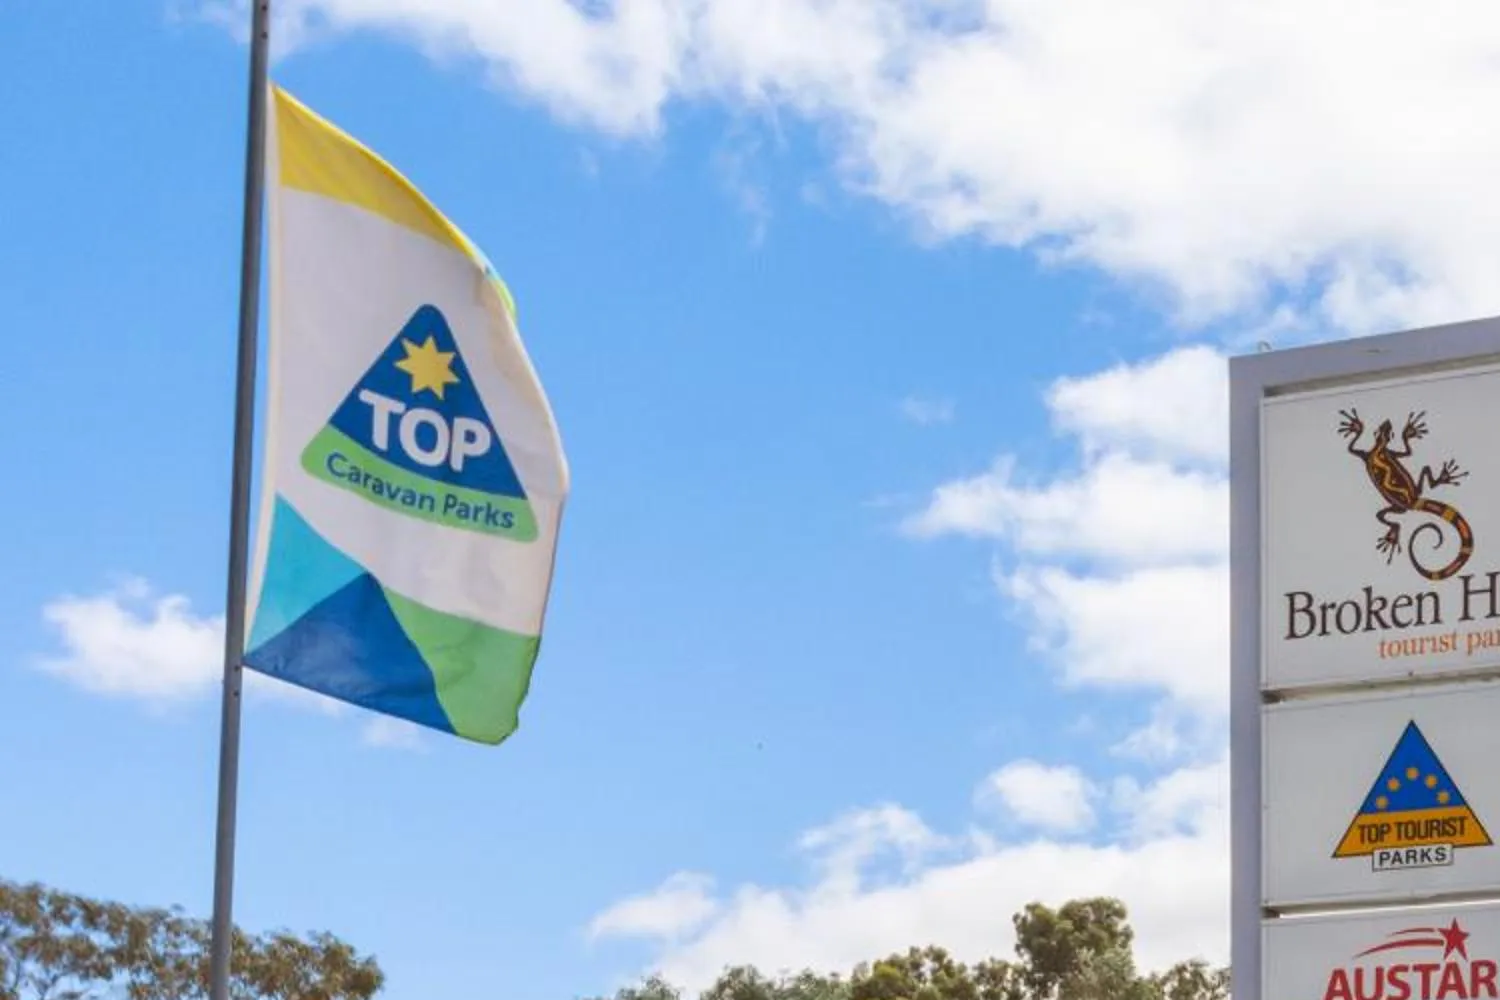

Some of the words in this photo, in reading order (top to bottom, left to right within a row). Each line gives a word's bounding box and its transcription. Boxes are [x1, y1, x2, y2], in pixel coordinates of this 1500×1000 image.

[359, 389, 491, 471] TOP
[326, 451, 436, 513] Caravan
[441, 494, 515, 530] Parks
[1285, 586, 1441, 640] Broken
[1377, 628, 1459, 660] tourist
[1357, 823, 1392, 844] TOP
[1394, 815, 1469, 841] TOURIST
[1378, 846, 1448, 866] PARKS
